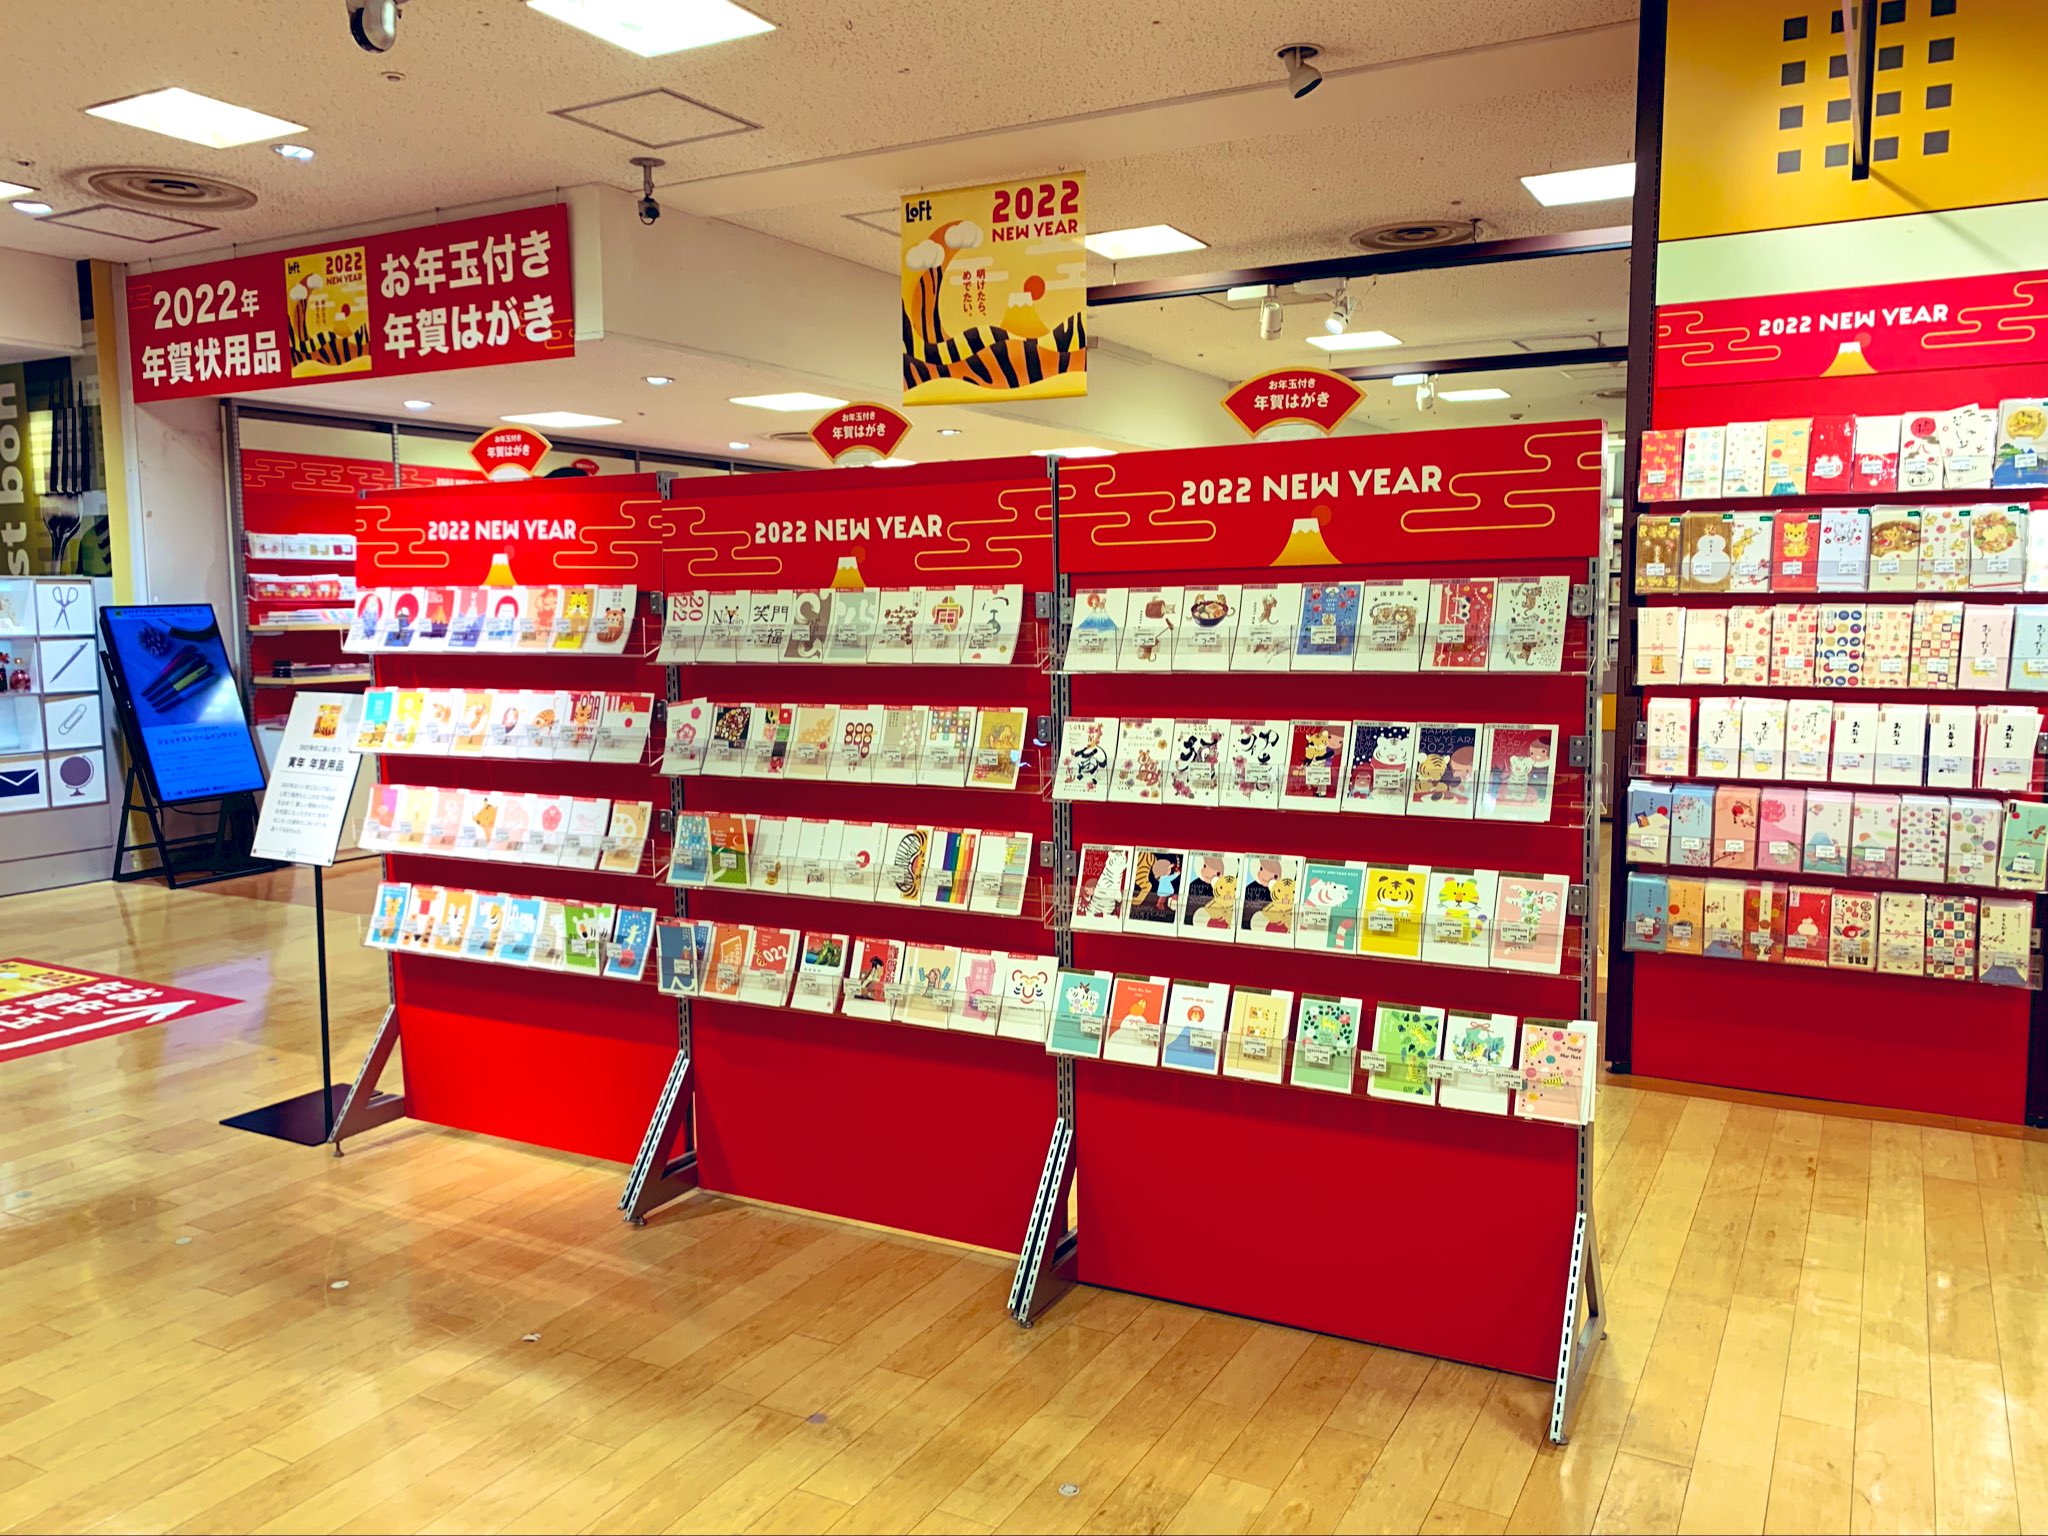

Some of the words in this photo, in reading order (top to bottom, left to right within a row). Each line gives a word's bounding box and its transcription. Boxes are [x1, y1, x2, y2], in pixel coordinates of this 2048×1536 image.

[992, 180, 1079, 223] 2022
[992, 224, 1029, 242] NEW
[1034, 219, 1078, 238] YEAR
[326, 252, 362, 275] 2022
[380, 230, 551, 298] お年玉付き
[153, 280, 260, 330] 2022年
[962, 271, 973, 317] めでたい。
[976, 268, 987, 316] 明けたら、
[383, 294, 554, 359] 年賀はがき
[1758, 316, 1812, 337] 2022
[1819, 308, 1876, 332] NEW
[1882, 304, 1949, 327] YEAR
[142, 330, 281, 387] 年賀状用品
[1253, 391, 1330, 411] 年賀はがき
[1268, 378, 1316, 390] お年玉付き
[832, 423, 887, 440] 年賀はがき
[1181, 477, 1251, 506] 2022
[1263, 471, 1339, 502] NEW
[1348, 465, 1442, 497] YEAR
[428, 520, 470, 541] 2022
[475, 520, 520, 540] NEW
[523, 519, 576, 540] YEAR
[755, 520, 807, 544] 2022
[815, 518, 870, 542] NEW
[876, 514, 943, 539] YEAR
[1419, 743, 1454, 753] 2022
[0, 987, 164, 1032] お年玉
